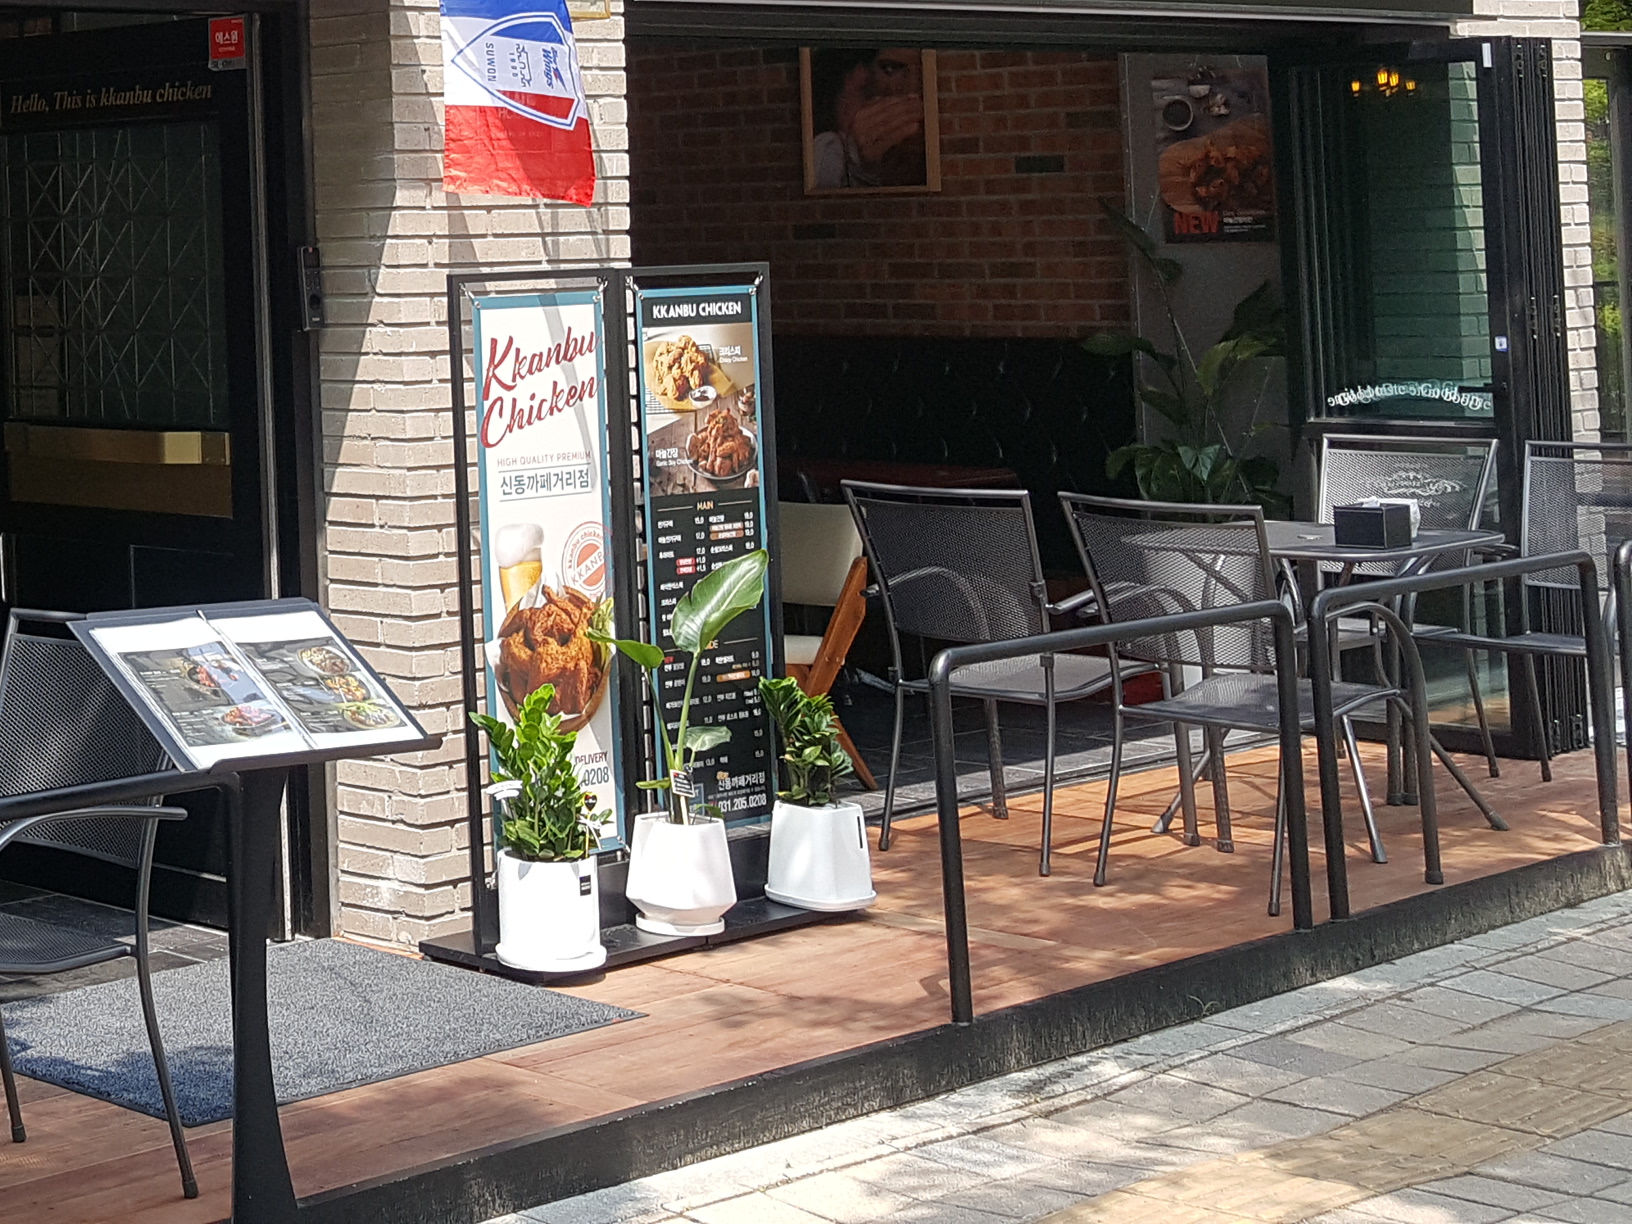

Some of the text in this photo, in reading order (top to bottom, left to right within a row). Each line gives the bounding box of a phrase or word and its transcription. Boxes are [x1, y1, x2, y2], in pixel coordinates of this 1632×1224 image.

[485, 42, 497, 82] SUWON
[54, 88, 82, 111] This
[85, 88, 97, 109] is
[99, 84, 153, 107] kkanbu
[156, 80, 212, 103] chicken
[1174, 210, 1220, 235] NEW
[652, 301, 742, 319] KKANBU CHICKEN
[483, 326, 601, 402] Kkanbu
[481, 376, 601, 449] Chicken
[497, 450, 591, 468] HIGH QUALITY PREMIUM
[500, 468, 590, 496] 신동까페거리점
